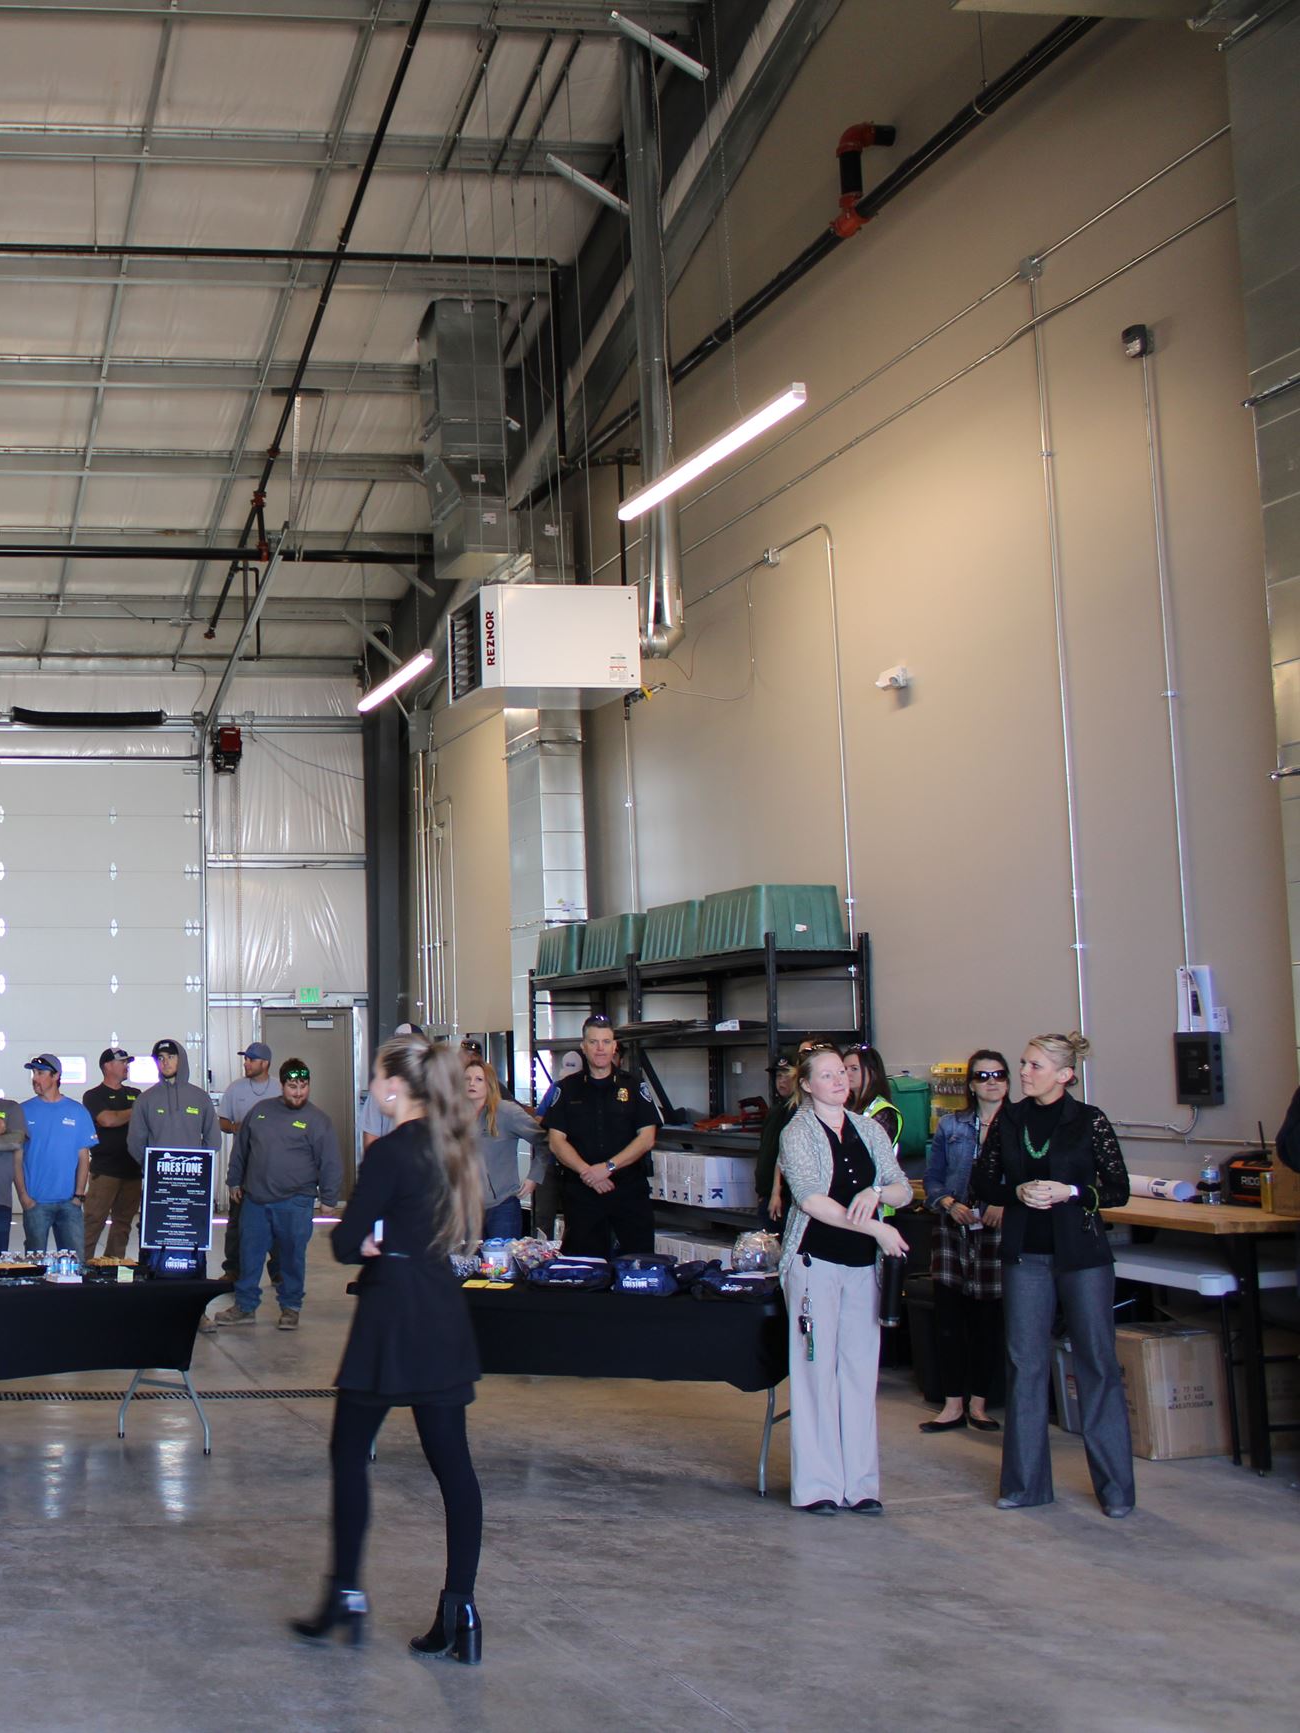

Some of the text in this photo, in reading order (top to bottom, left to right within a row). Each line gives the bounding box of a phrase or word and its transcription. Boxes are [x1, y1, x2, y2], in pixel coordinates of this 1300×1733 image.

[486, 611, 496, 666] REZNOR
[300, 987, 319, 1003] EXIT
[157, 1161, 203, 1174] FIRESTONE
[711, 1188, 724, 1200] K
